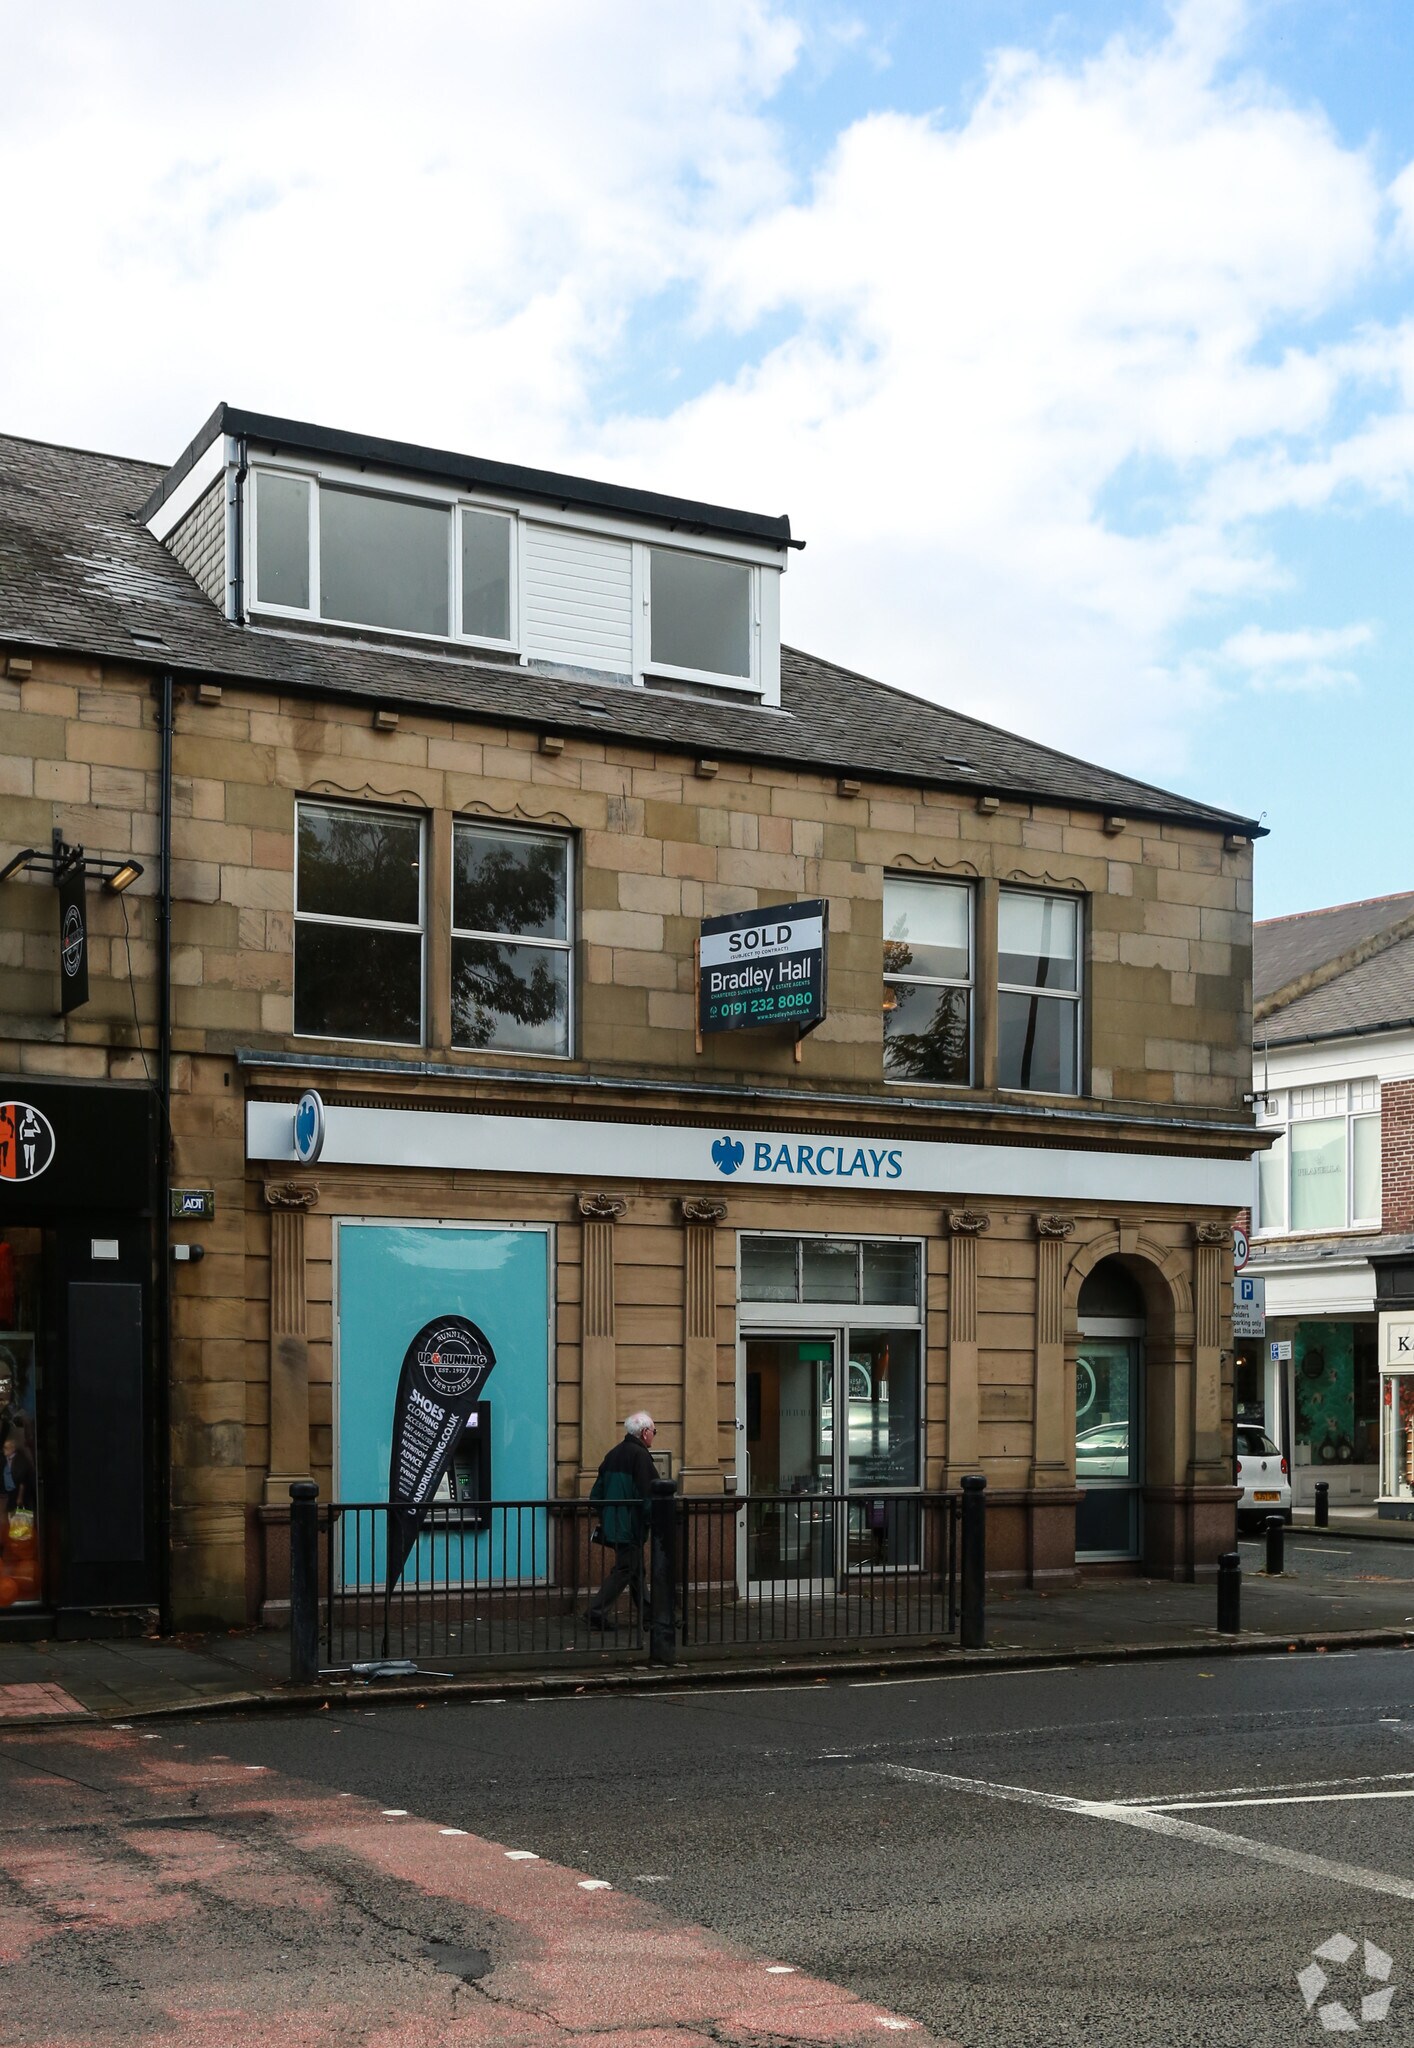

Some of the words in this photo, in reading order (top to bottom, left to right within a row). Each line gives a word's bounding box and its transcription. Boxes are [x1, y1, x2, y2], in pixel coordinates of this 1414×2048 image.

[729, 925, 792, 952] SOLD
[710, 966, 774, 992] Bradley
[779, 957, 811, 982] Hall
[710, 991, 737, 1000] CHARTERED
[737, 987, 763, 996] SURVEYORS
[792, 979, 811, 987] AGENTS
[721, 1001, 747, 1016] 0191
[750, 997, 774, 1013] 232
[778, 991, 813, 1009] 8080
[757, 1008, 810, 1020] www.bradleyhall.co.uk
[753, 1142, 903, 1179] BARCLAYS
[183, 1198, 204, 1209] ADT
[1243, 1282, 1252, 1299] P
[1233, 1302, 1249, 1310] Permit
[1252, 1319, 1262, 1327] only
[1252, 1327, 1264, 1335] point
[436, 1330, 471, 1345] RUNNING
[431, 1376, 472, 1393] HERITAGE
[409, 1388, 446, 1421] SHOES
[405, 1413, 438, 1439] ACCESSORIES
[407, 1403, 439, 1430] CLOTHING
[400, 1449, 423, 1468] ADVICE
[401, 1438, 427, 1460] NUTRITION
[399, 1466, 417, 1481] EVENTS
[408, 1412, 460, 1515] UANDRUNNING.CO.UK
